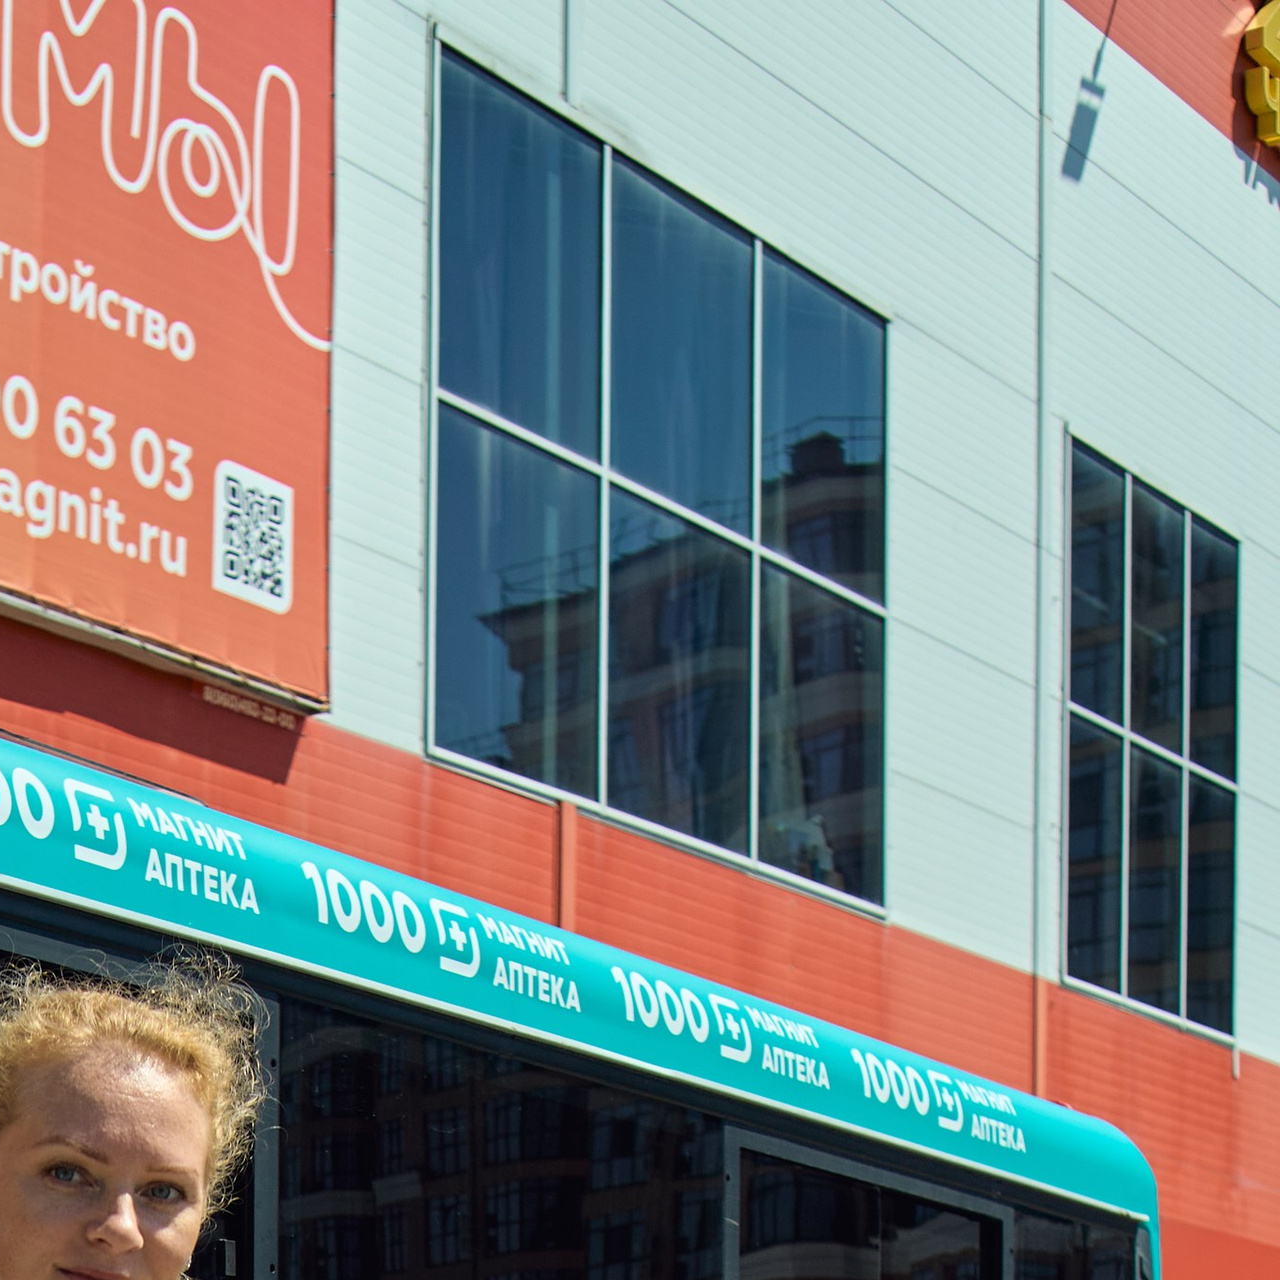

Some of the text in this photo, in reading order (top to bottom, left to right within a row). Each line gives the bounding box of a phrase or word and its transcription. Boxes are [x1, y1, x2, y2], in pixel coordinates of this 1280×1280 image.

[54, 396, 117, 470] 63
[130, 428, 194, 502] 03
[126, 796, 247, 861] МАГНИТ
[144, 847, 260, 915] АПТЕКА
[301, 861, 426, 954] 1000
[476, 911, 571, 966] МАГНИТ
[493, 956, 581, 1013] АПТЕКА
[611, 965, 710, 1043] 1000
[747, 1004, 819, 1049] МАГНИТ
[762, 1043, 830, 1090] АПТЕКА
[850, 1047, 930, 1116] 1000
[956, 1077, 1018, 1117] МАГНИТ
[971, 1113, 1026, 1153] АПТЕКА
